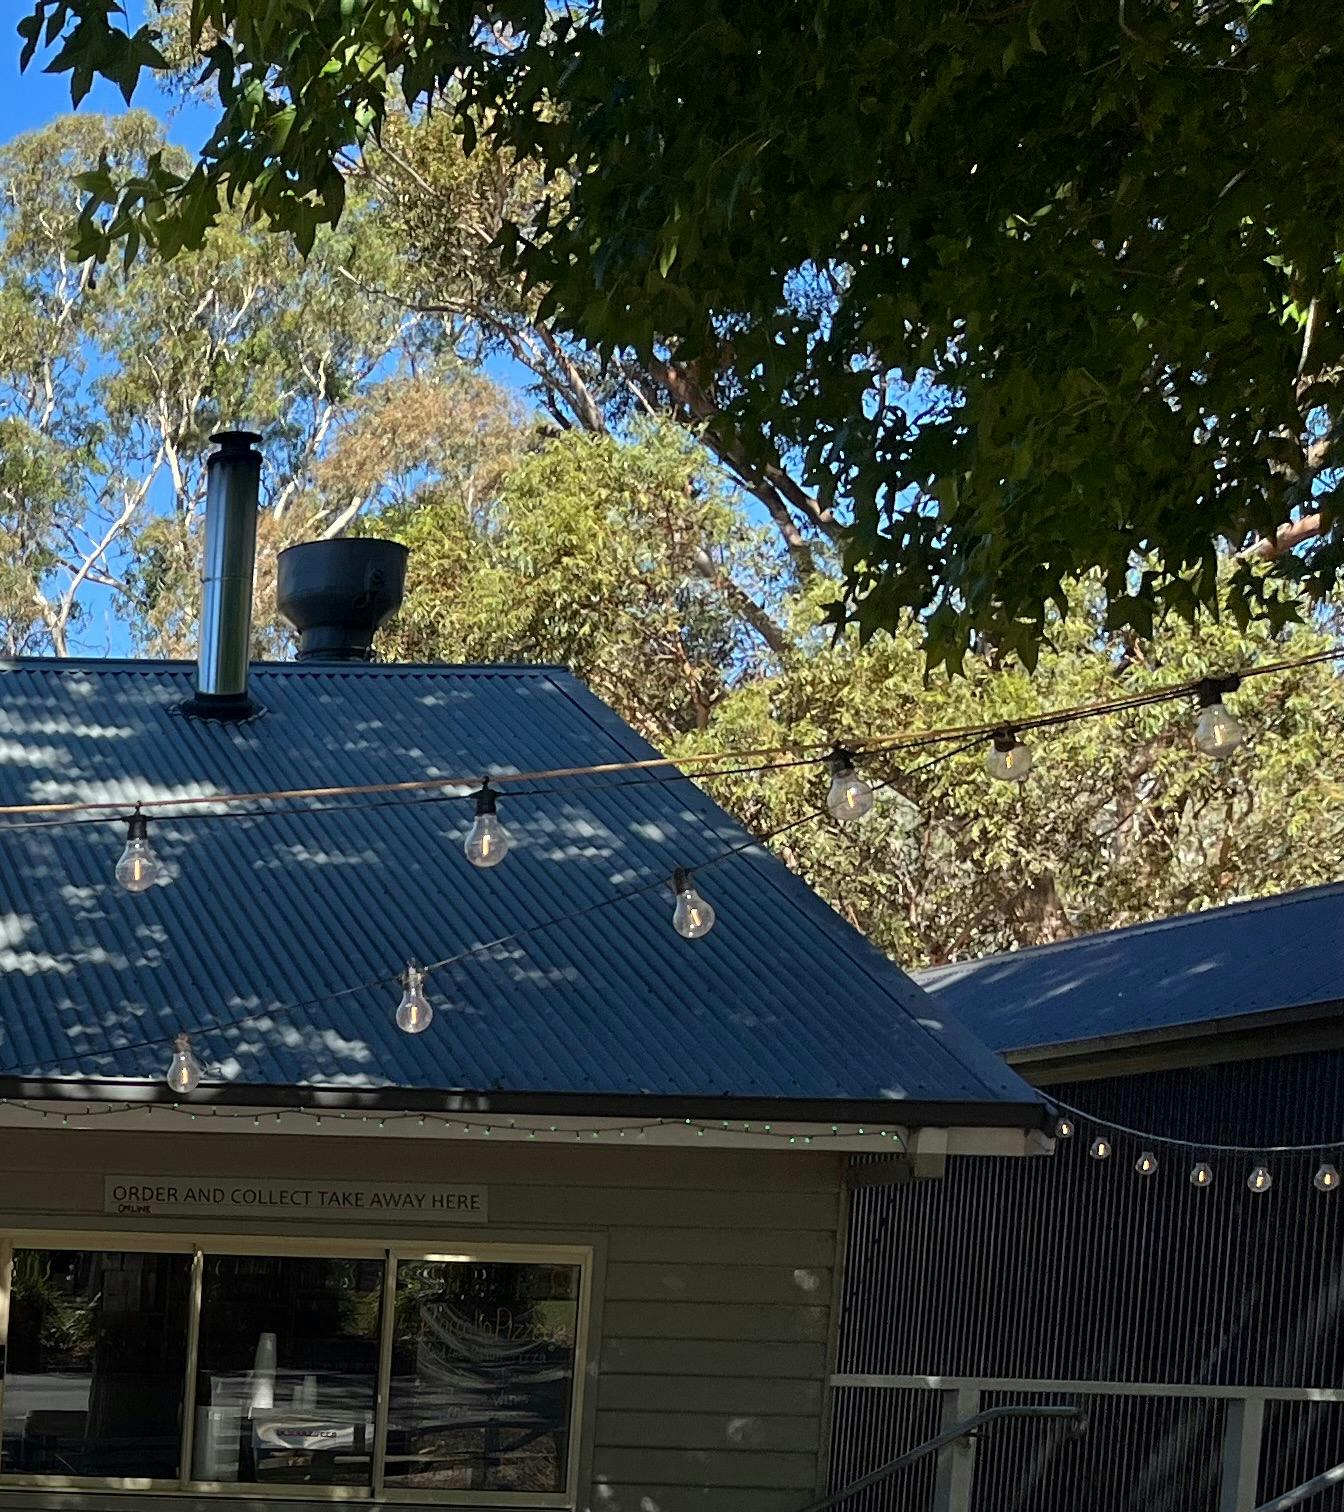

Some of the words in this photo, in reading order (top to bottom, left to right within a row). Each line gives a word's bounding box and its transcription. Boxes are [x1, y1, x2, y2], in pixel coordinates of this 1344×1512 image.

[112, 1185, 178, 1202] ORDER
[184, 1187, 225, 1203] AND
[230, 1188, 312, 1206] COLLECT
[318, 1191, 365, 1208] TAKE
[369, 1192, 427, 1209] AWAY
[431, 1194, 481, 1210] HERE
